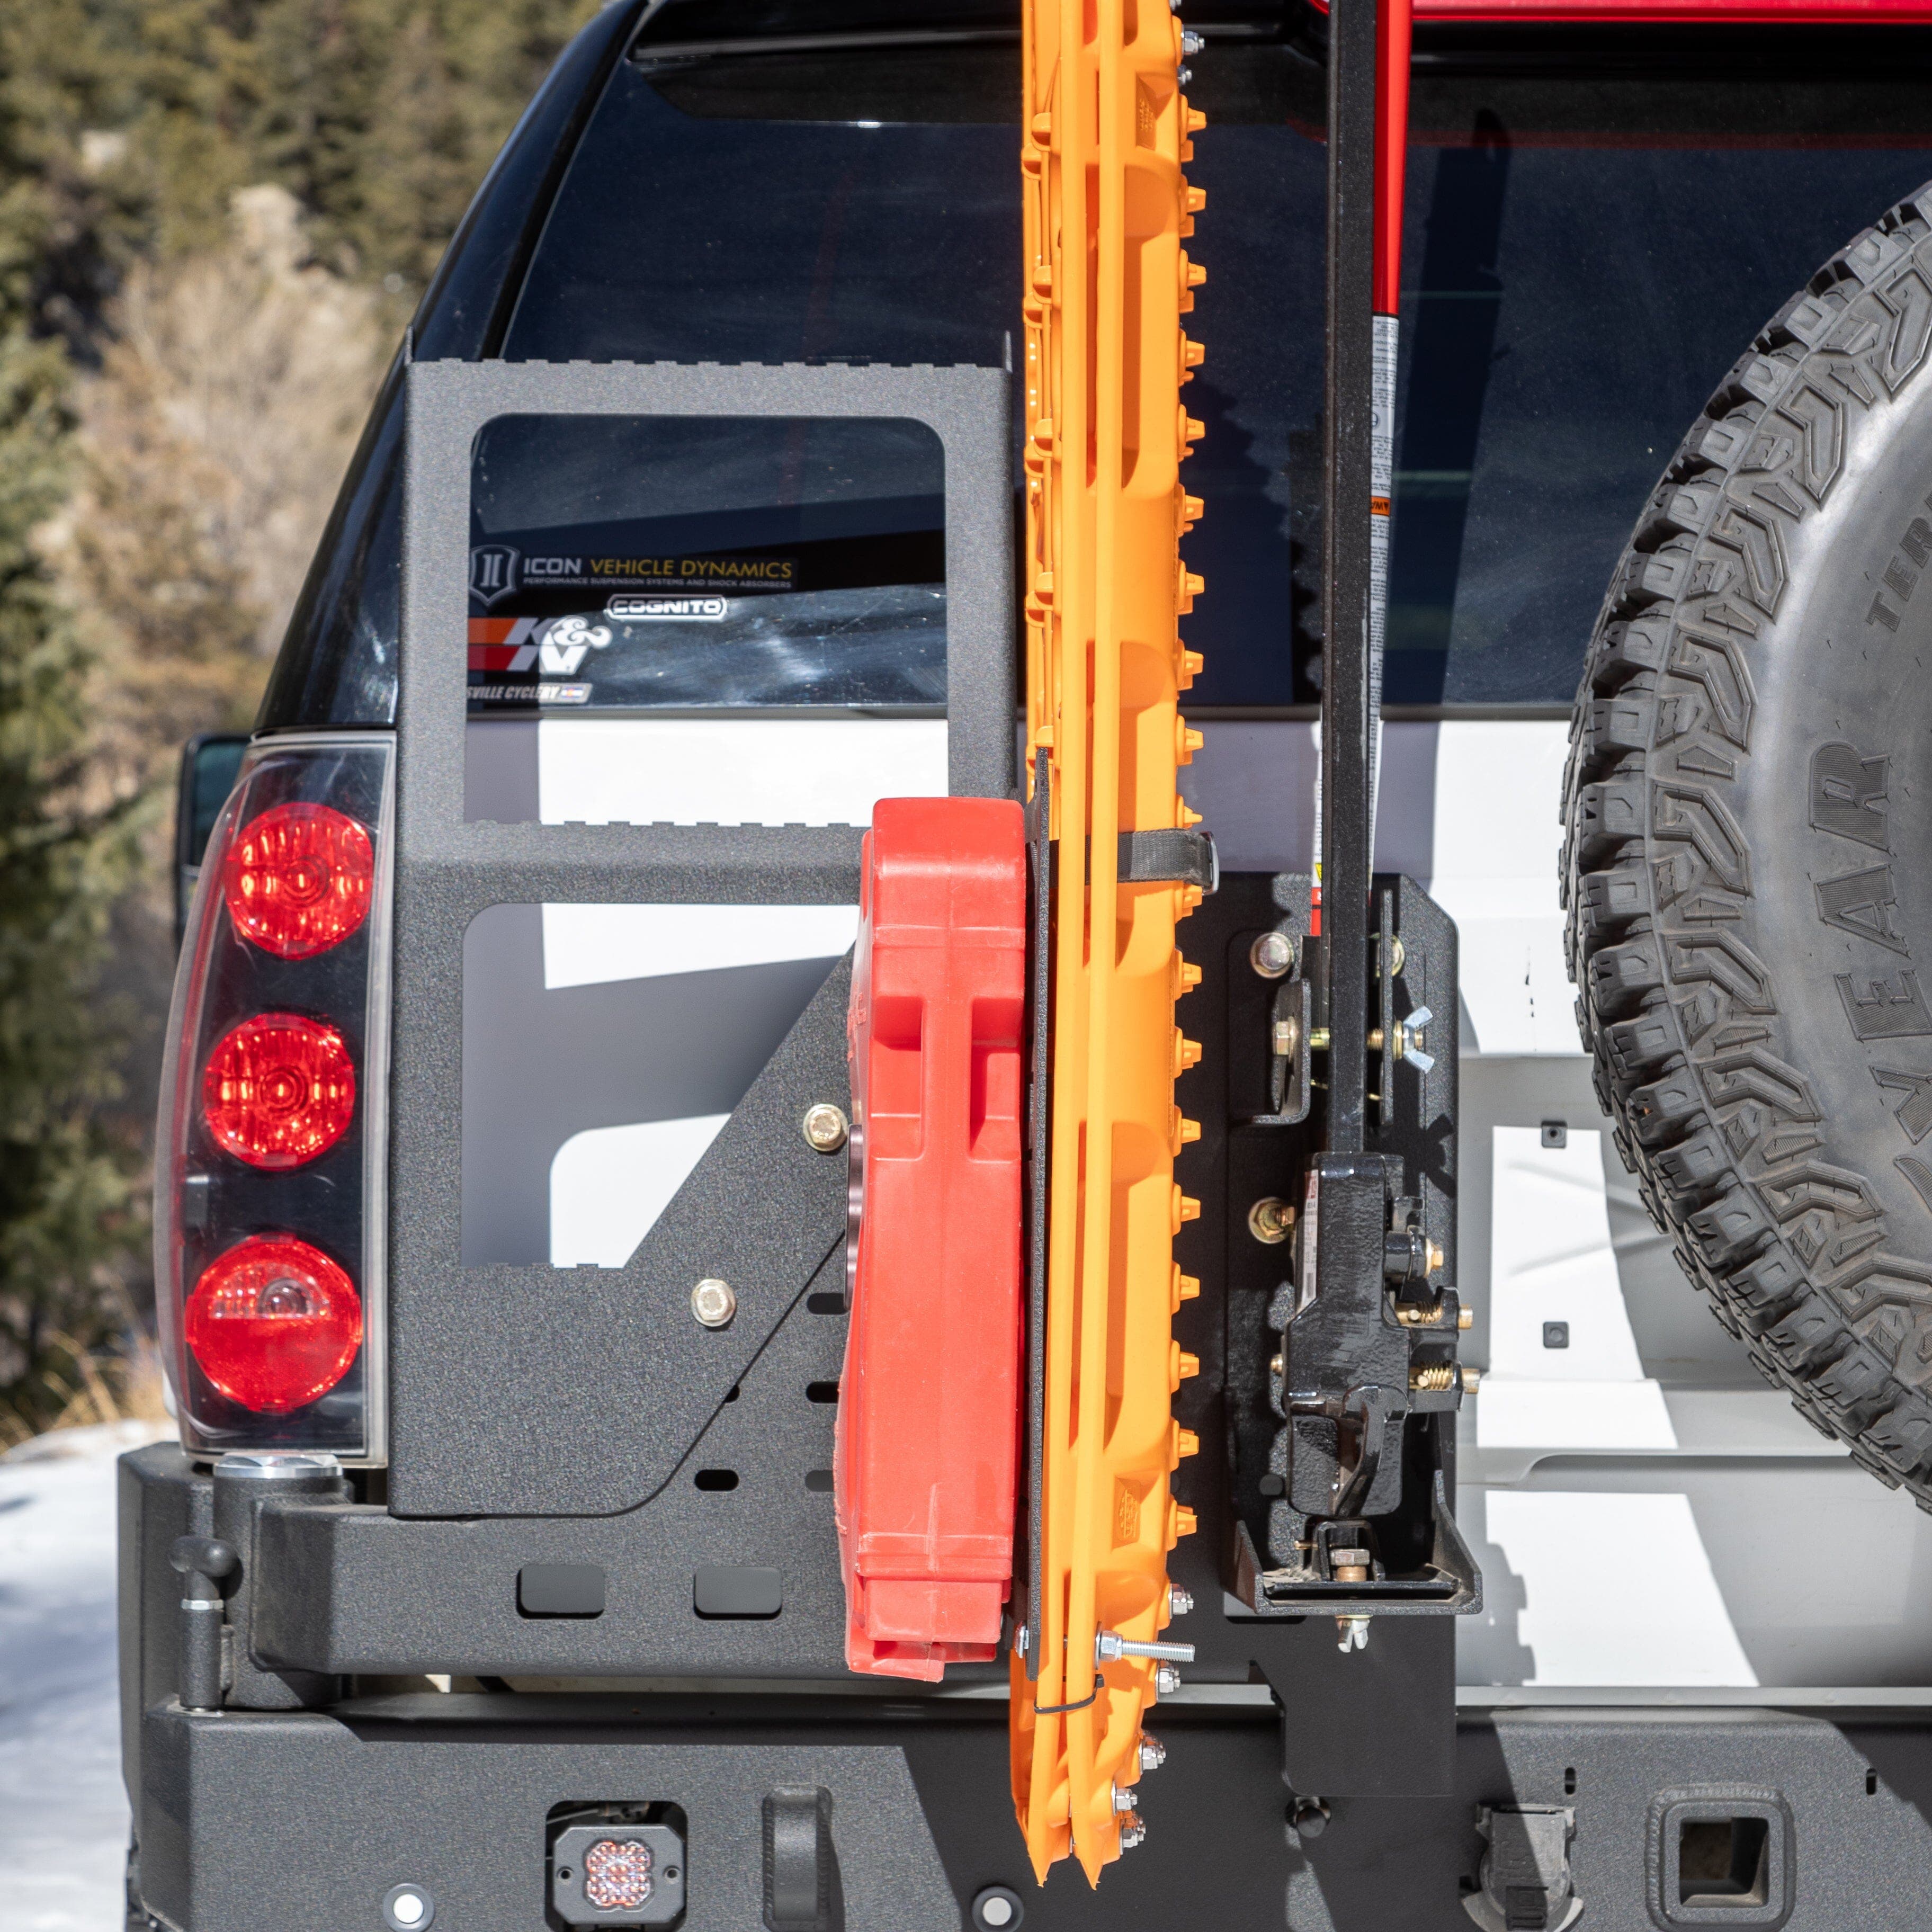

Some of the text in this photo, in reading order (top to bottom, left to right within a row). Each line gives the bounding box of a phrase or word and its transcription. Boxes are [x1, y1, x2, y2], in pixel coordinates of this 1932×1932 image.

[524, 558, 792, 578] ICON VEHICLE DYNAMICS
[1865, 491, 1932, 633] TER
[646, 578, 684, 586] SYSTEMS
[739, 580, 792, 588] ABSORBERS
[613, 600, 721, 614] COGNITO
[1809, 741, 1932, 1214] YEAR
